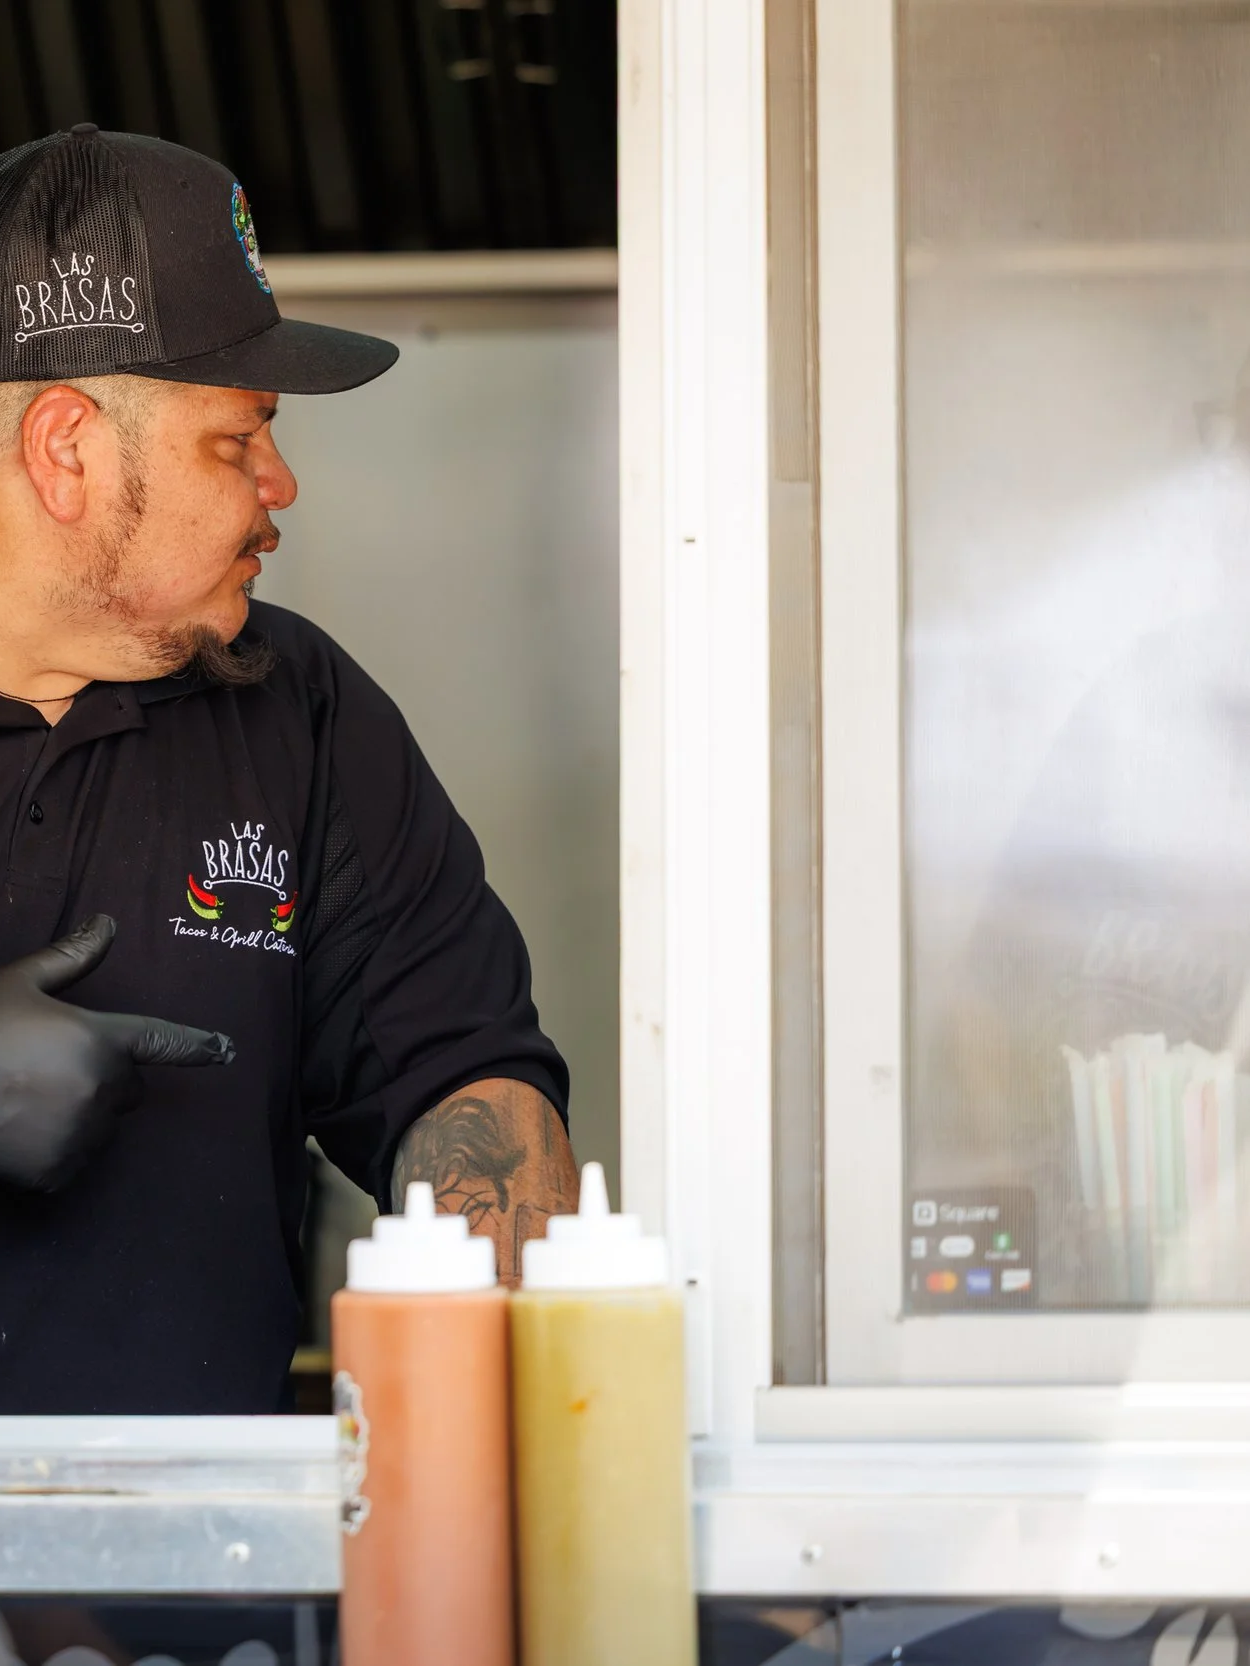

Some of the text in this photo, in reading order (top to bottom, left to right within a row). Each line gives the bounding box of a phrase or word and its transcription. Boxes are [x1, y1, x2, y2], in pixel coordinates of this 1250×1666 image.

[52, 252, 95, 278] LAS
[15, 277, 136, 328] BRASAS
[230, 821, 265, 840] LAS
[202, 839, 289, 887] BRASAS
[168, 916, 209, 937] Tacos
[210, 926, 219, 940] &
[221, 926, 263, 948] Grill
